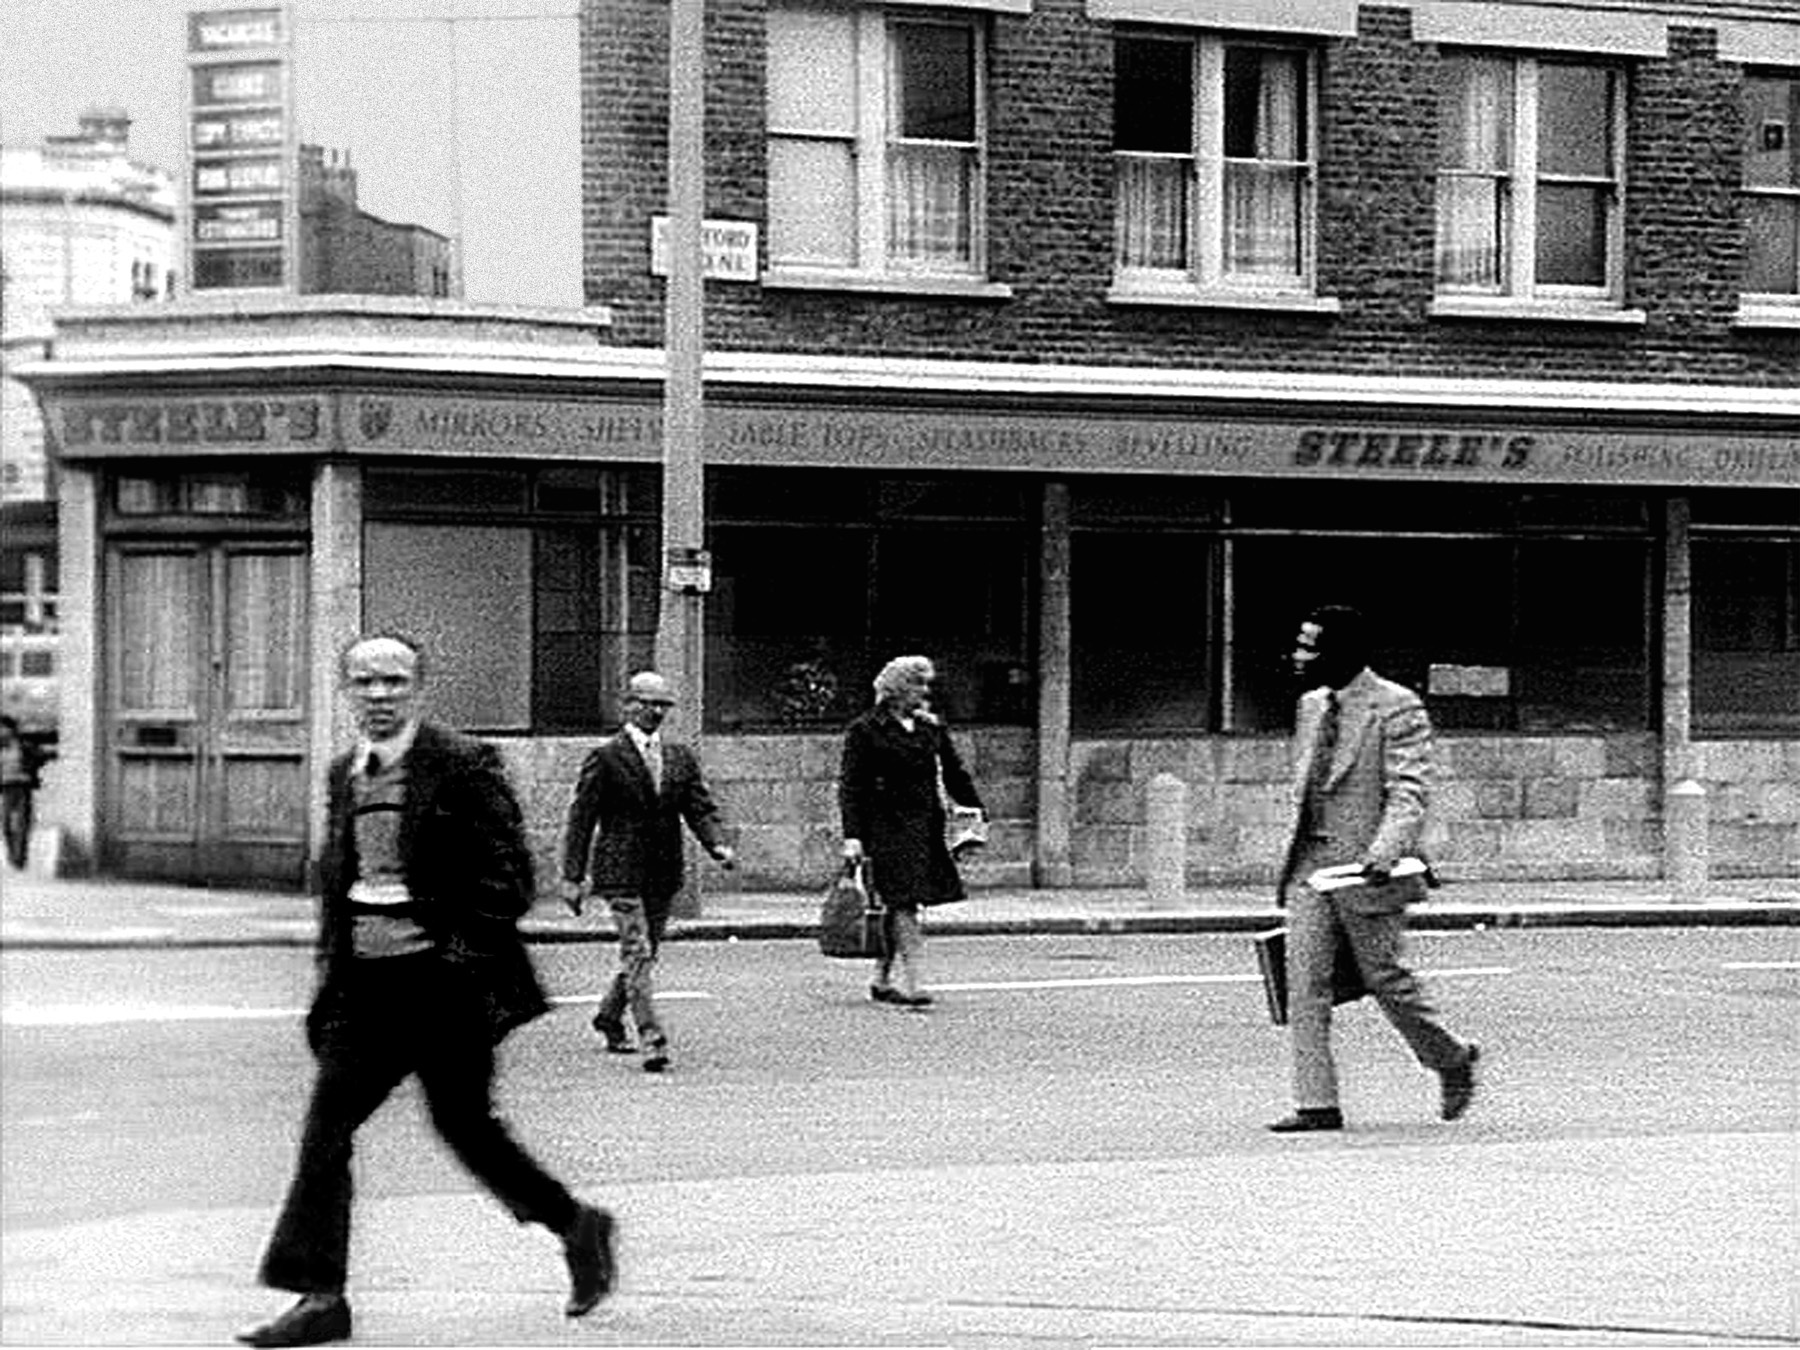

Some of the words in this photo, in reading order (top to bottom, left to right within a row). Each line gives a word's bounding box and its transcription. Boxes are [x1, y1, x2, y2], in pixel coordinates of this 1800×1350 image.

[416, 408, 547, 438] MIRRORS
[728, 421, 805, 446] TABLE
[1296, 430, 1537, 470] STEELE'S
